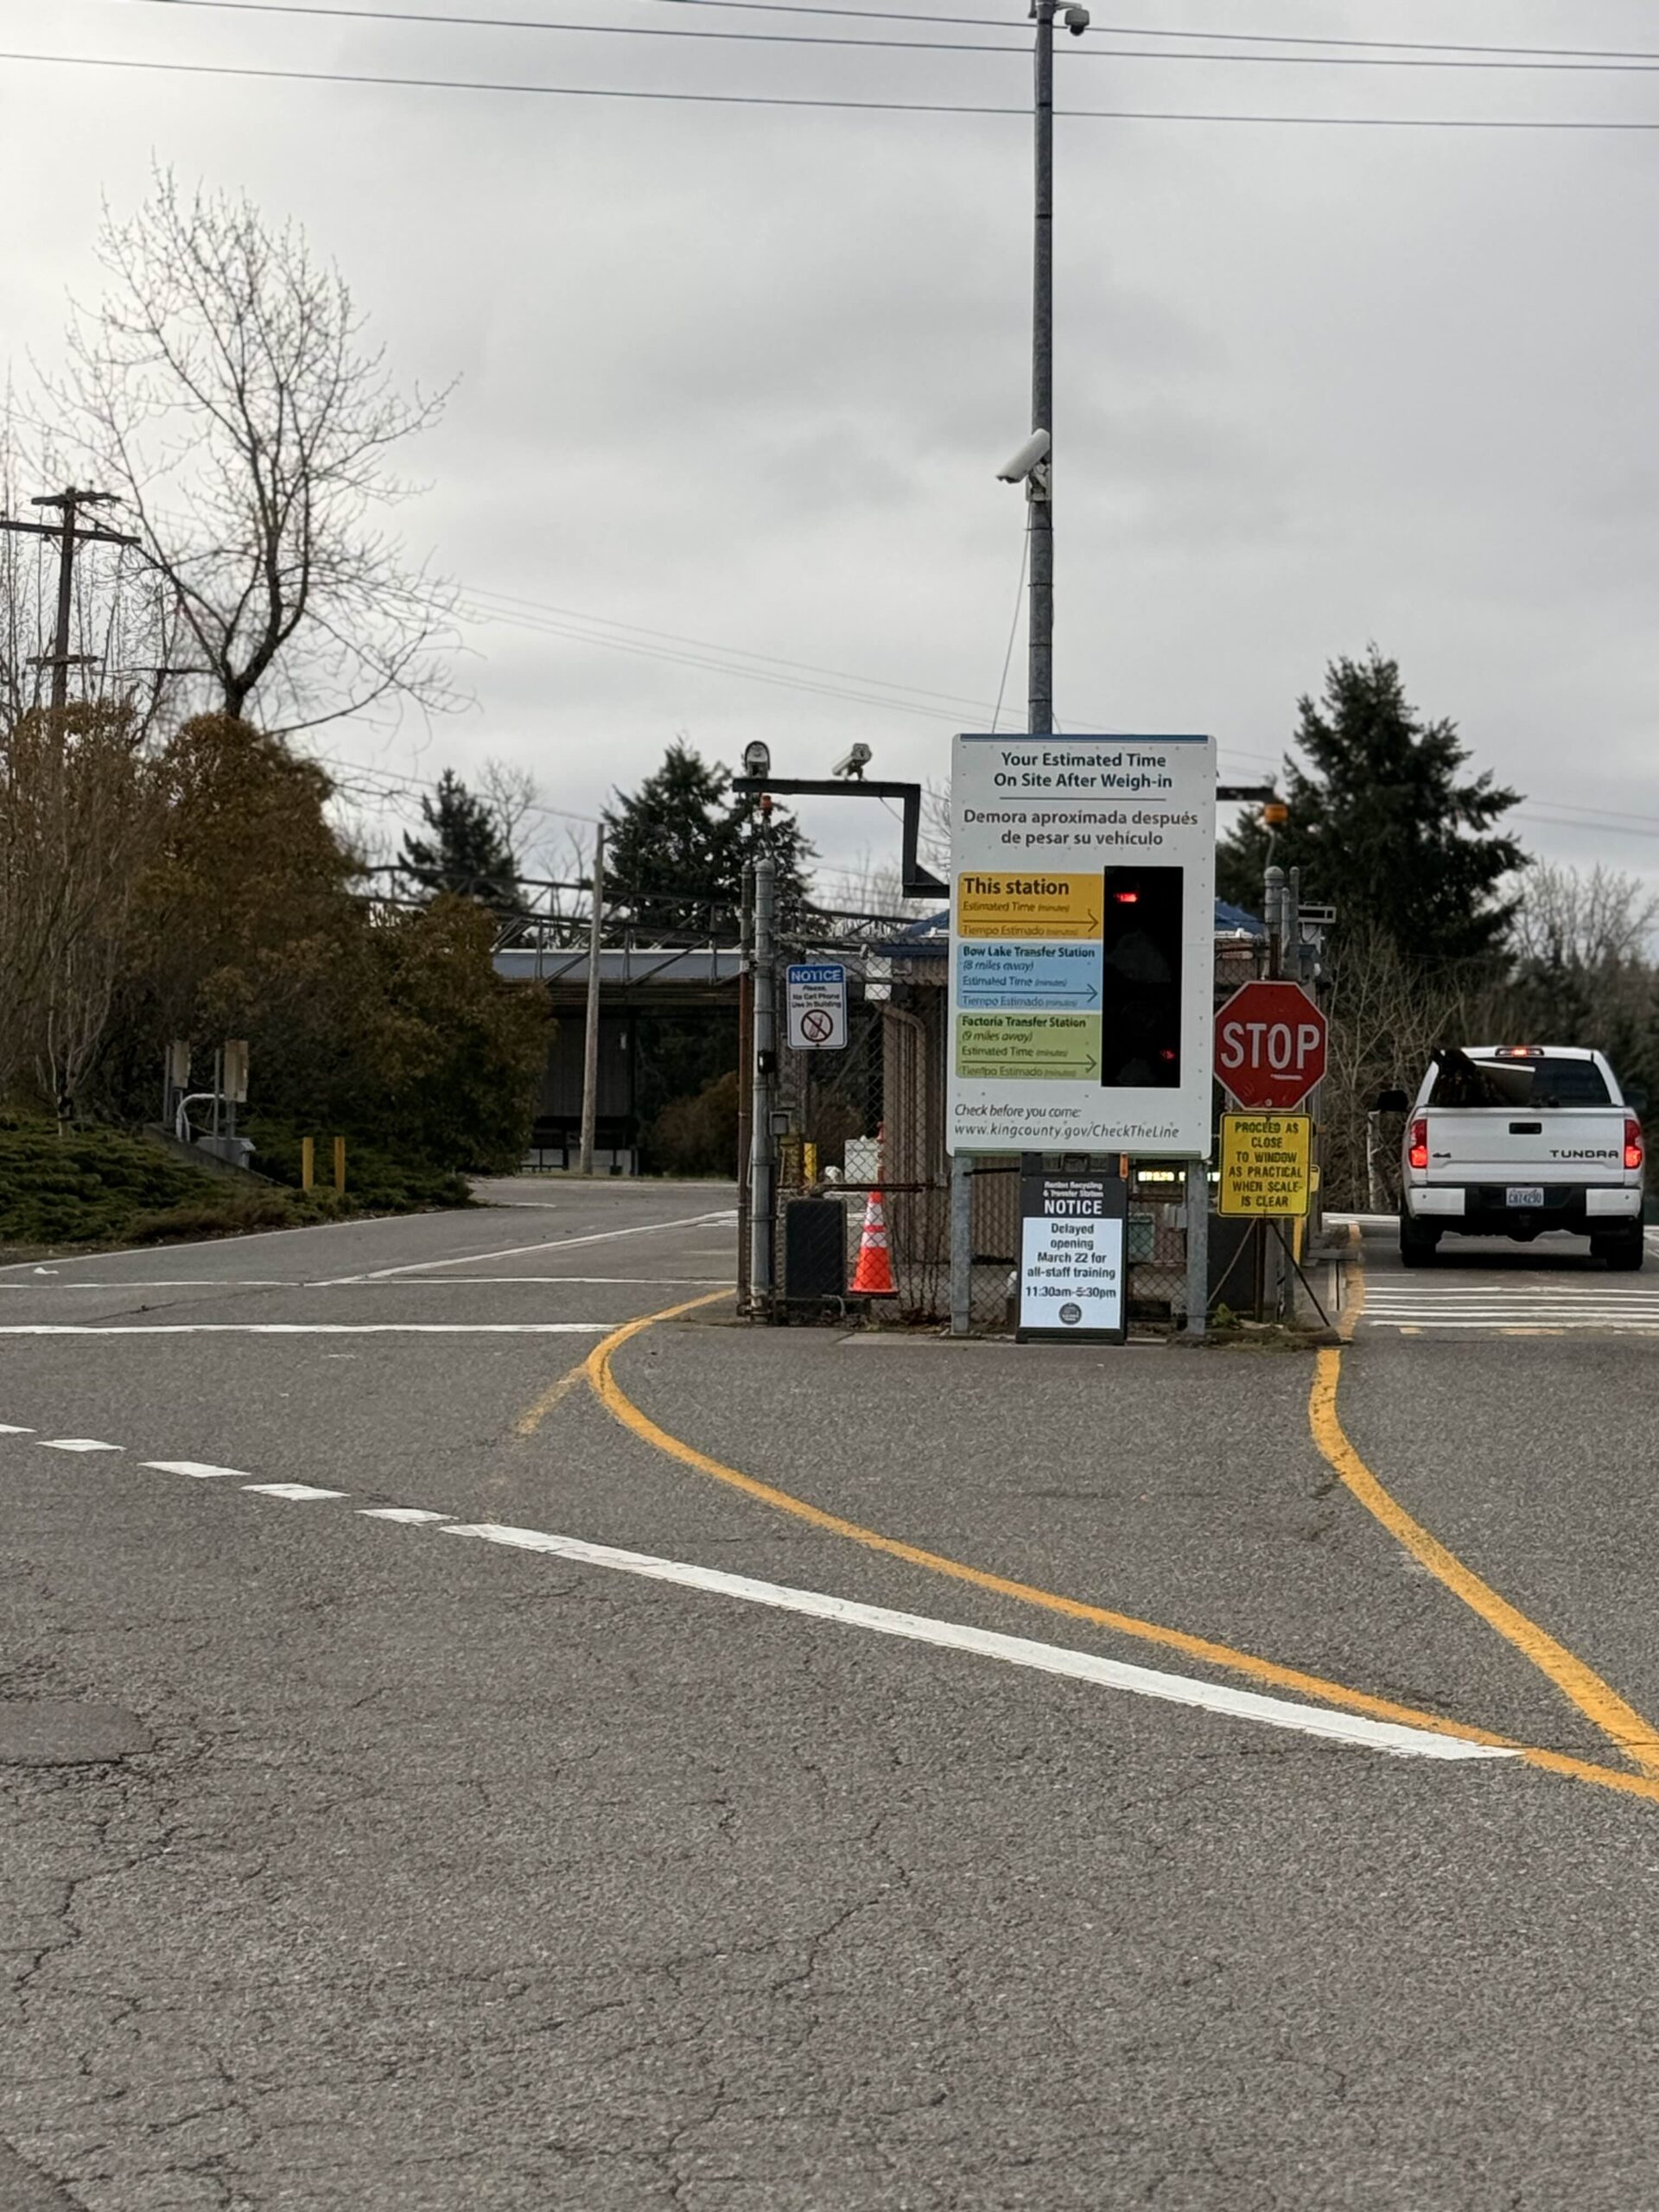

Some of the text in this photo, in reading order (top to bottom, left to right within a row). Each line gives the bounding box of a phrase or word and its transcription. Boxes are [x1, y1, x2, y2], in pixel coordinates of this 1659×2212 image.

[1001, 752, 1166, 767] Your Estimated Time
[994, 772, 1173, 791] On Site After Weigh-in
[964, 809, 1198, 829] Demora aproximada después
[1001, 830, 1163, 848] de pesar su vehículo
[963, 877, 1070, 895] This station
[963, 901, 1009, 912] Estimated
[1012, 902, 1035, 912] Time
[963, 925, 999, 937] Tiempo
[1001, 925, 1045, 936] Estimado
[963, 946, 1095, 957] Bow Lake Transfer Station
[975, 960, 1001, 970] miles
[1003, 962, 1034, 973] away)
[791, 969, 841, 982] NOTICE
[963, 976, 1006, 986] Estimated
[1009, 976, 1033, 986] Time
[963, 996, 999, 1007] Tiempo
[1001, 996, 1045, 1007] Estimado
[962, 1015, 1086, 1027] Factoria Transfer Station
[974, 1031, 1000, 1040] miles
[1001, 1032, 1033, 1043] away)
[962, 1046, 1007, 1056] Estimated
[1011, 1046, 1034, 1057] Time
[1220, 1021, 1320, 1070] STOP
[962, 1065, 997, 1077] Tiempo
[1000, 1066, 1043, 1077] Estimado
[955, 1103, 988, 1116] Check
[989, 1104, 1024, 1117] before
[1026, 1108, 1046, 1120] you
[954, 1123, 1179, 1139] www.kingcounty.gov/CheckTheLine
[1285, 1122, 1299, 1135] AS
[1251, 1136, 1283, 1148] CLOSE
[1236, 1151, 1297, 1163] TO WINDOW
[1549, 1149, 1619, 1159] TUNDRA
[1229, 1166, 1243, 1178] AS
[1247, 1166, 1302, 1178] PRACTICAL
[1232, 1181, 1263, 1192] WHEN
[1045, 1199, 1103, 1215] NOTICE
[1241, 1196, 1288, 1207] IS CLEAR
[1051, 1223, 1094, 1236] Delayed
[1051, 1239, 1094, 1250] opening
[1037, 1252, 1107, 1263] March 22 for
[1027, 1267, 1116, 1281] all-staff training
